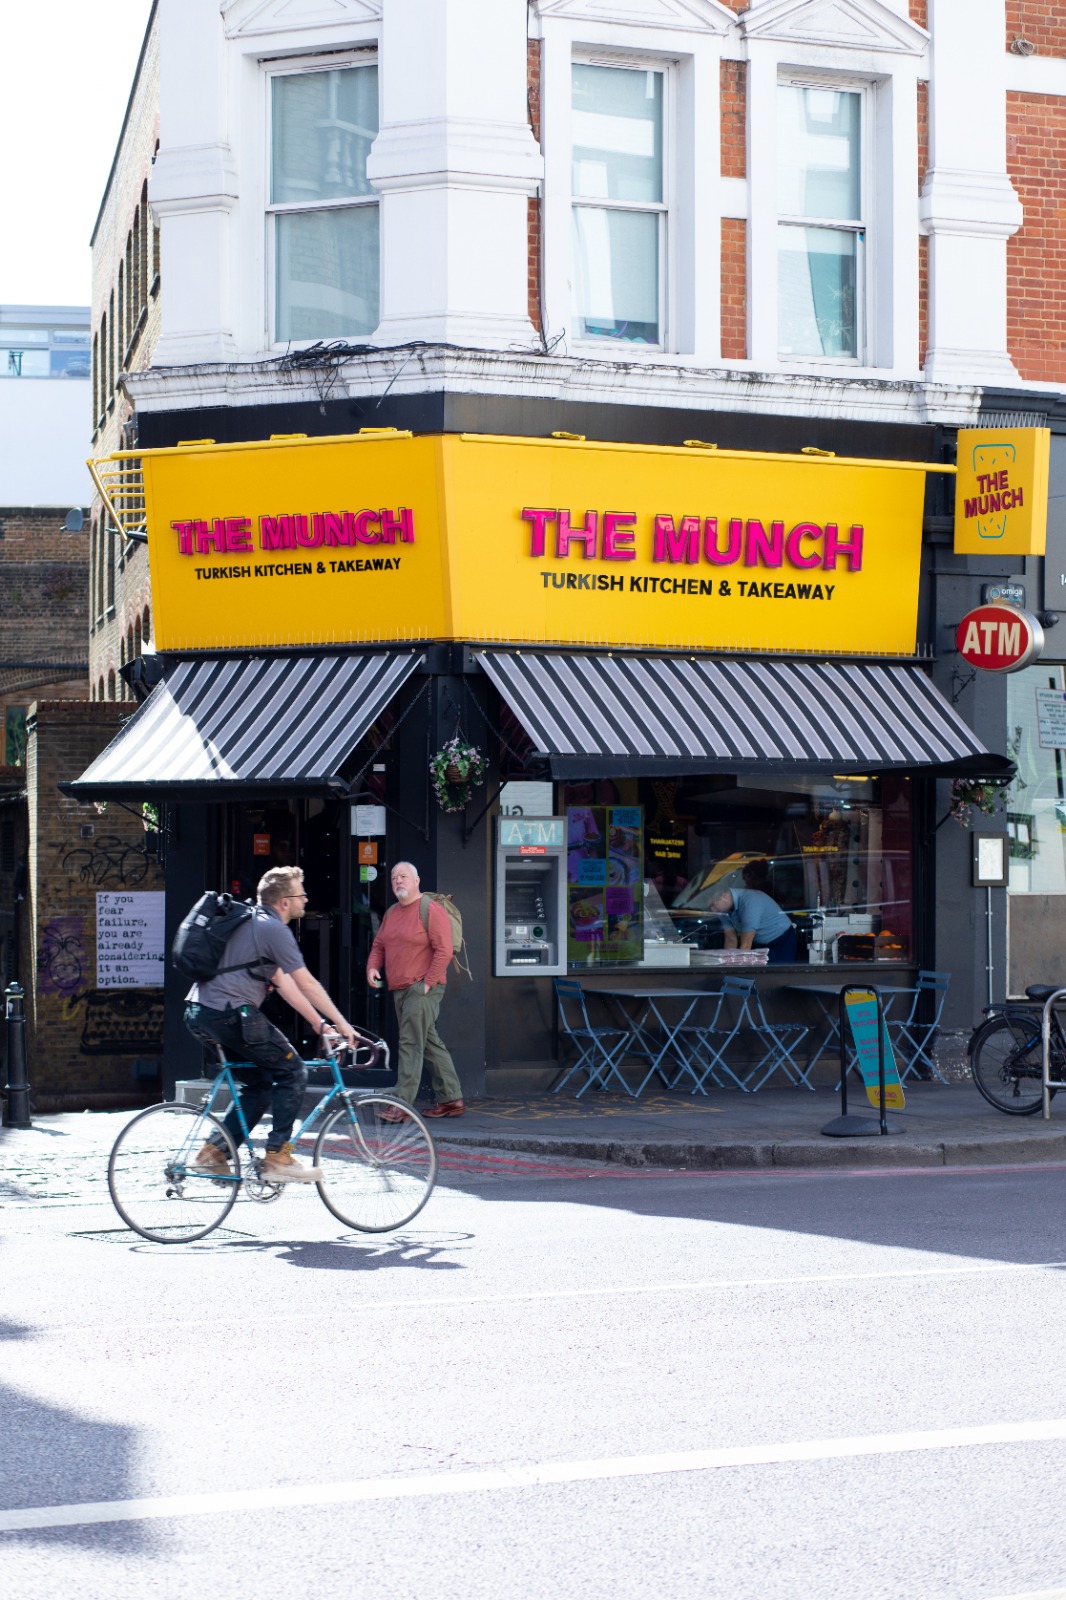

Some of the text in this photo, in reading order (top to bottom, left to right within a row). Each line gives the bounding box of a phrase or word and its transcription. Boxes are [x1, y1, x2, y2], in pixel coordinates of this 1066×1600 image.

[976, 470, 1008, 494] THE
[964, 487, 1024, 518] MUNCH
[171, 507, 415, 556] THE MUNCH
[521, 506, 864, 572] THE MUNCH
[195, 557, 401, 580] TURKISH KITCHEN & TAKEAWAY
[540, 571, 836, 601] TURKISH KITCHEN & TAKEAWAY
[962, 621, 1020, 656] ATM
[507, 822, 556, 843] ATM
[98, 894, 134, 905] If you
[98, 906, 124, 915] fear
[98, 917, 147, 927] failure,
[98, 930, 143, 940] you are
[98, 941, 144, 951] already
[98, 951, 165, 962] considering
[98, 964, 129, 972] it an
[98, 975, 140, 985] option.
